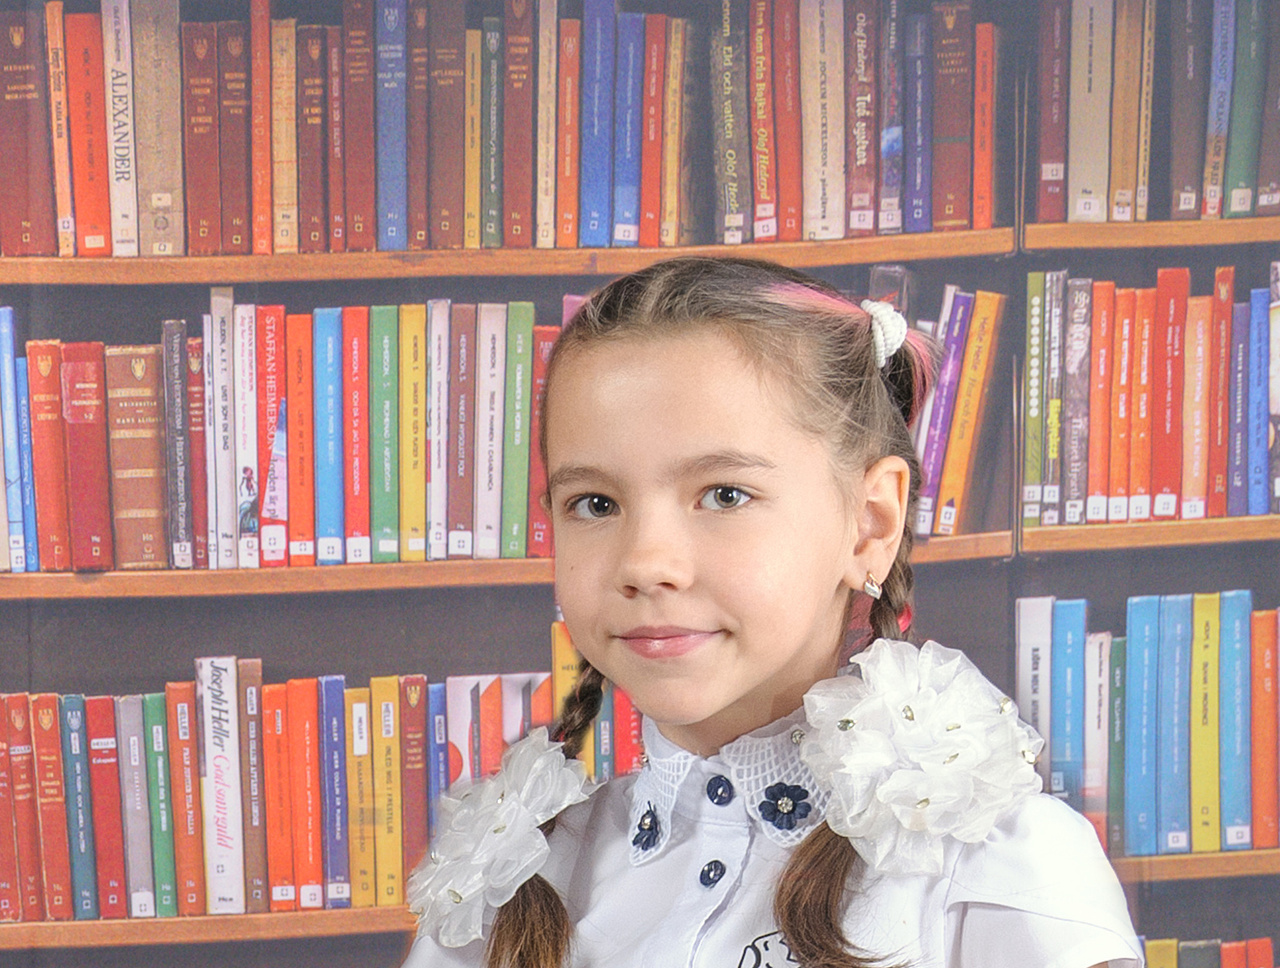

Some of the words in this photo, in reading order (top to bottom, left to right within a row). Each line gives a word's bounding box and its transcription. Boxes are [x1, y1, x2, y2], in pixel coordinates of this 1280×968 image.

[854, 14, 868, 38] Olof
[755, 27, 766, 54] kom
[722, 46, 734, 66] Eld
[756, 55, 768, 80] från
[854, 40, 869, 83] Hederyd
[723, 71, 735, 95] och
[723, 99, 735, 139] vatten
[855, 94, 871, 118] Två
[111, 69, 131, 183] ALEXANDER
[754, 128, 769, 153] Olof
[723, 149, 739, 177] Olof
[755, 154, 772, 200] Hederyd
[264, 316, 277, 373] STAFFAN
[221, 385, 229, 402] LIVET
[221, 405, 229, 421] SOM
[265, 376, 278, 450] HEIMERSON
[222, 436, 230, 451] DAG
[268, 458, 280, 493] Jorden
[269, 495, 280, 506] är
[208, 660, 229, 705] Joseph
[211, 705, 231, 751] Heller
[214, 754, 231, 785] God
[215, 785, 230, 814] som
[214, 815, 234, 850] guld
